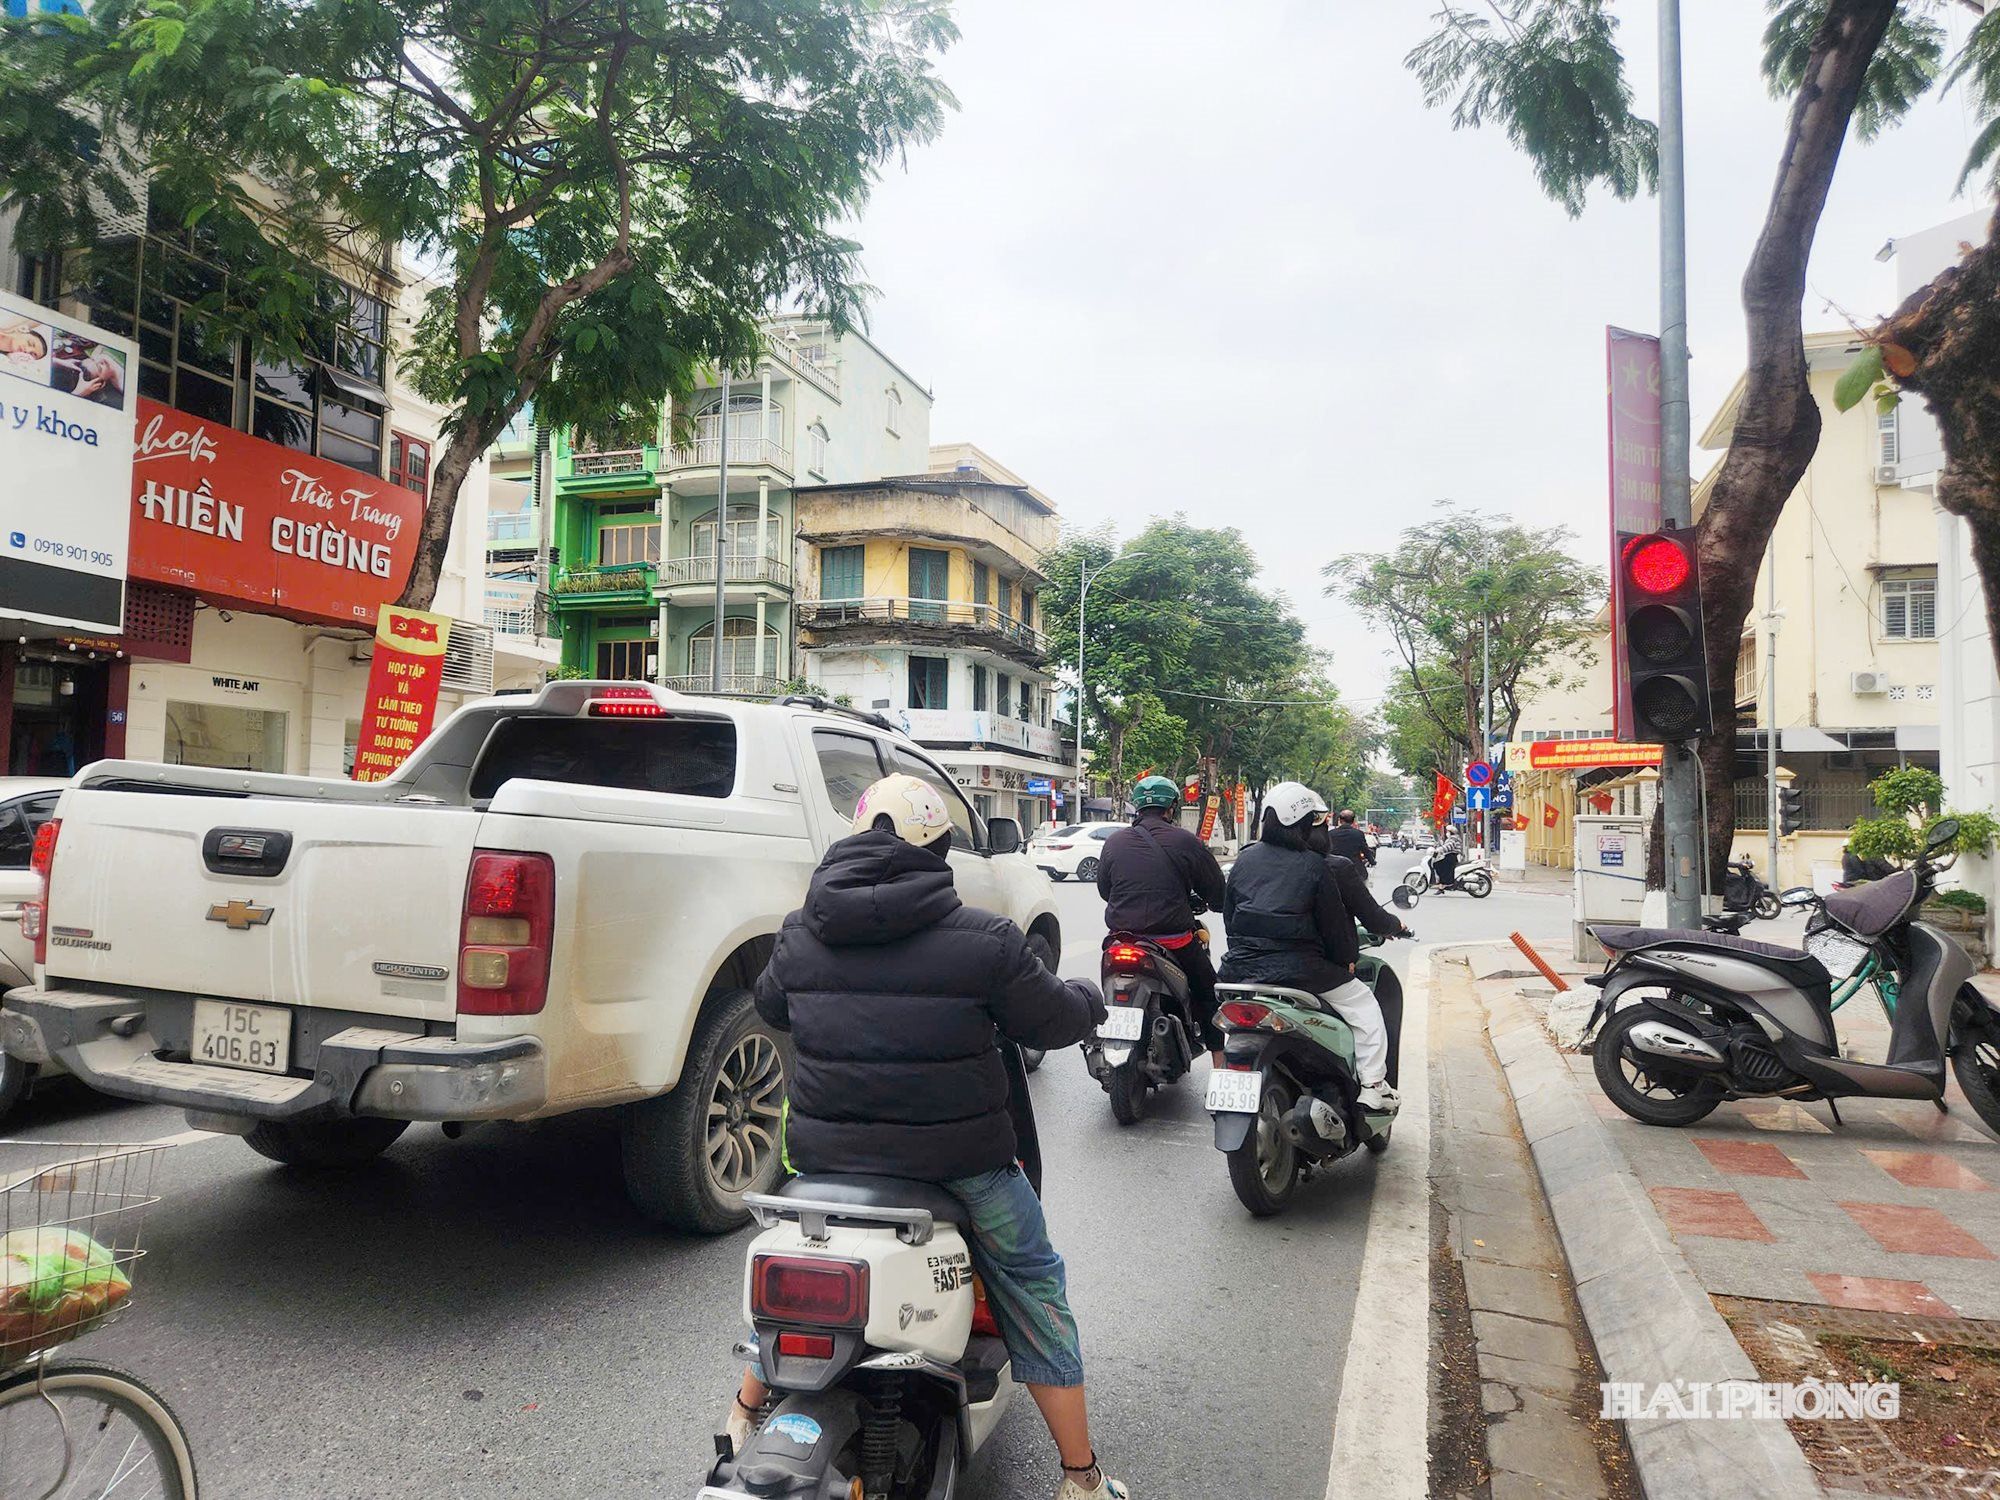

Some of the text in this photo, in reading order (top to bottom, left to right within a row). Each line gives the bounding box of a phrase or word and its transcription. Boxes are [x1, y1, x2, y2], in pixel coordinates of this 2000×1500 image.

[36, 405, 99, 447] khoa
[133, 413, 218, 464] hop
[138, 477, 245, 542] HIỀN
[281, 468, 403, 541] Thời Trang
[34, 538, 113, 567] 0918 901 905
[271, 515, 392, 578] CƯỜNG
[387, 661, 426, 681] HỌC TẬP
[212, 676, 260, 692] WHITE ANT
[397, 680, 409, 695] VÀ
[377, 696, 423, 715] LÀM THEO
[111, 712, 123, 722] 56
[375, 715, 418, 734] TƯ TƯỞNG
[374, 733, 413, 751] ĐẠO ĐỨC
[361, 751, 392, 767] PHONG
[357, 767, 370, 782] HỒ
[51, 936, 112, 951] COLORADO
[375, 963, 443, 977] HIGH COUNTRY
[223, 1006, 262, 1035] 15C
[1111, 1010, 1136, 1025] 5-AA
[202, 1033, 276, 1067] 406.83
[1218, 1073, 1253, 1091] 15-B3
[1209, 1090, 1257, 1110] 035.96
